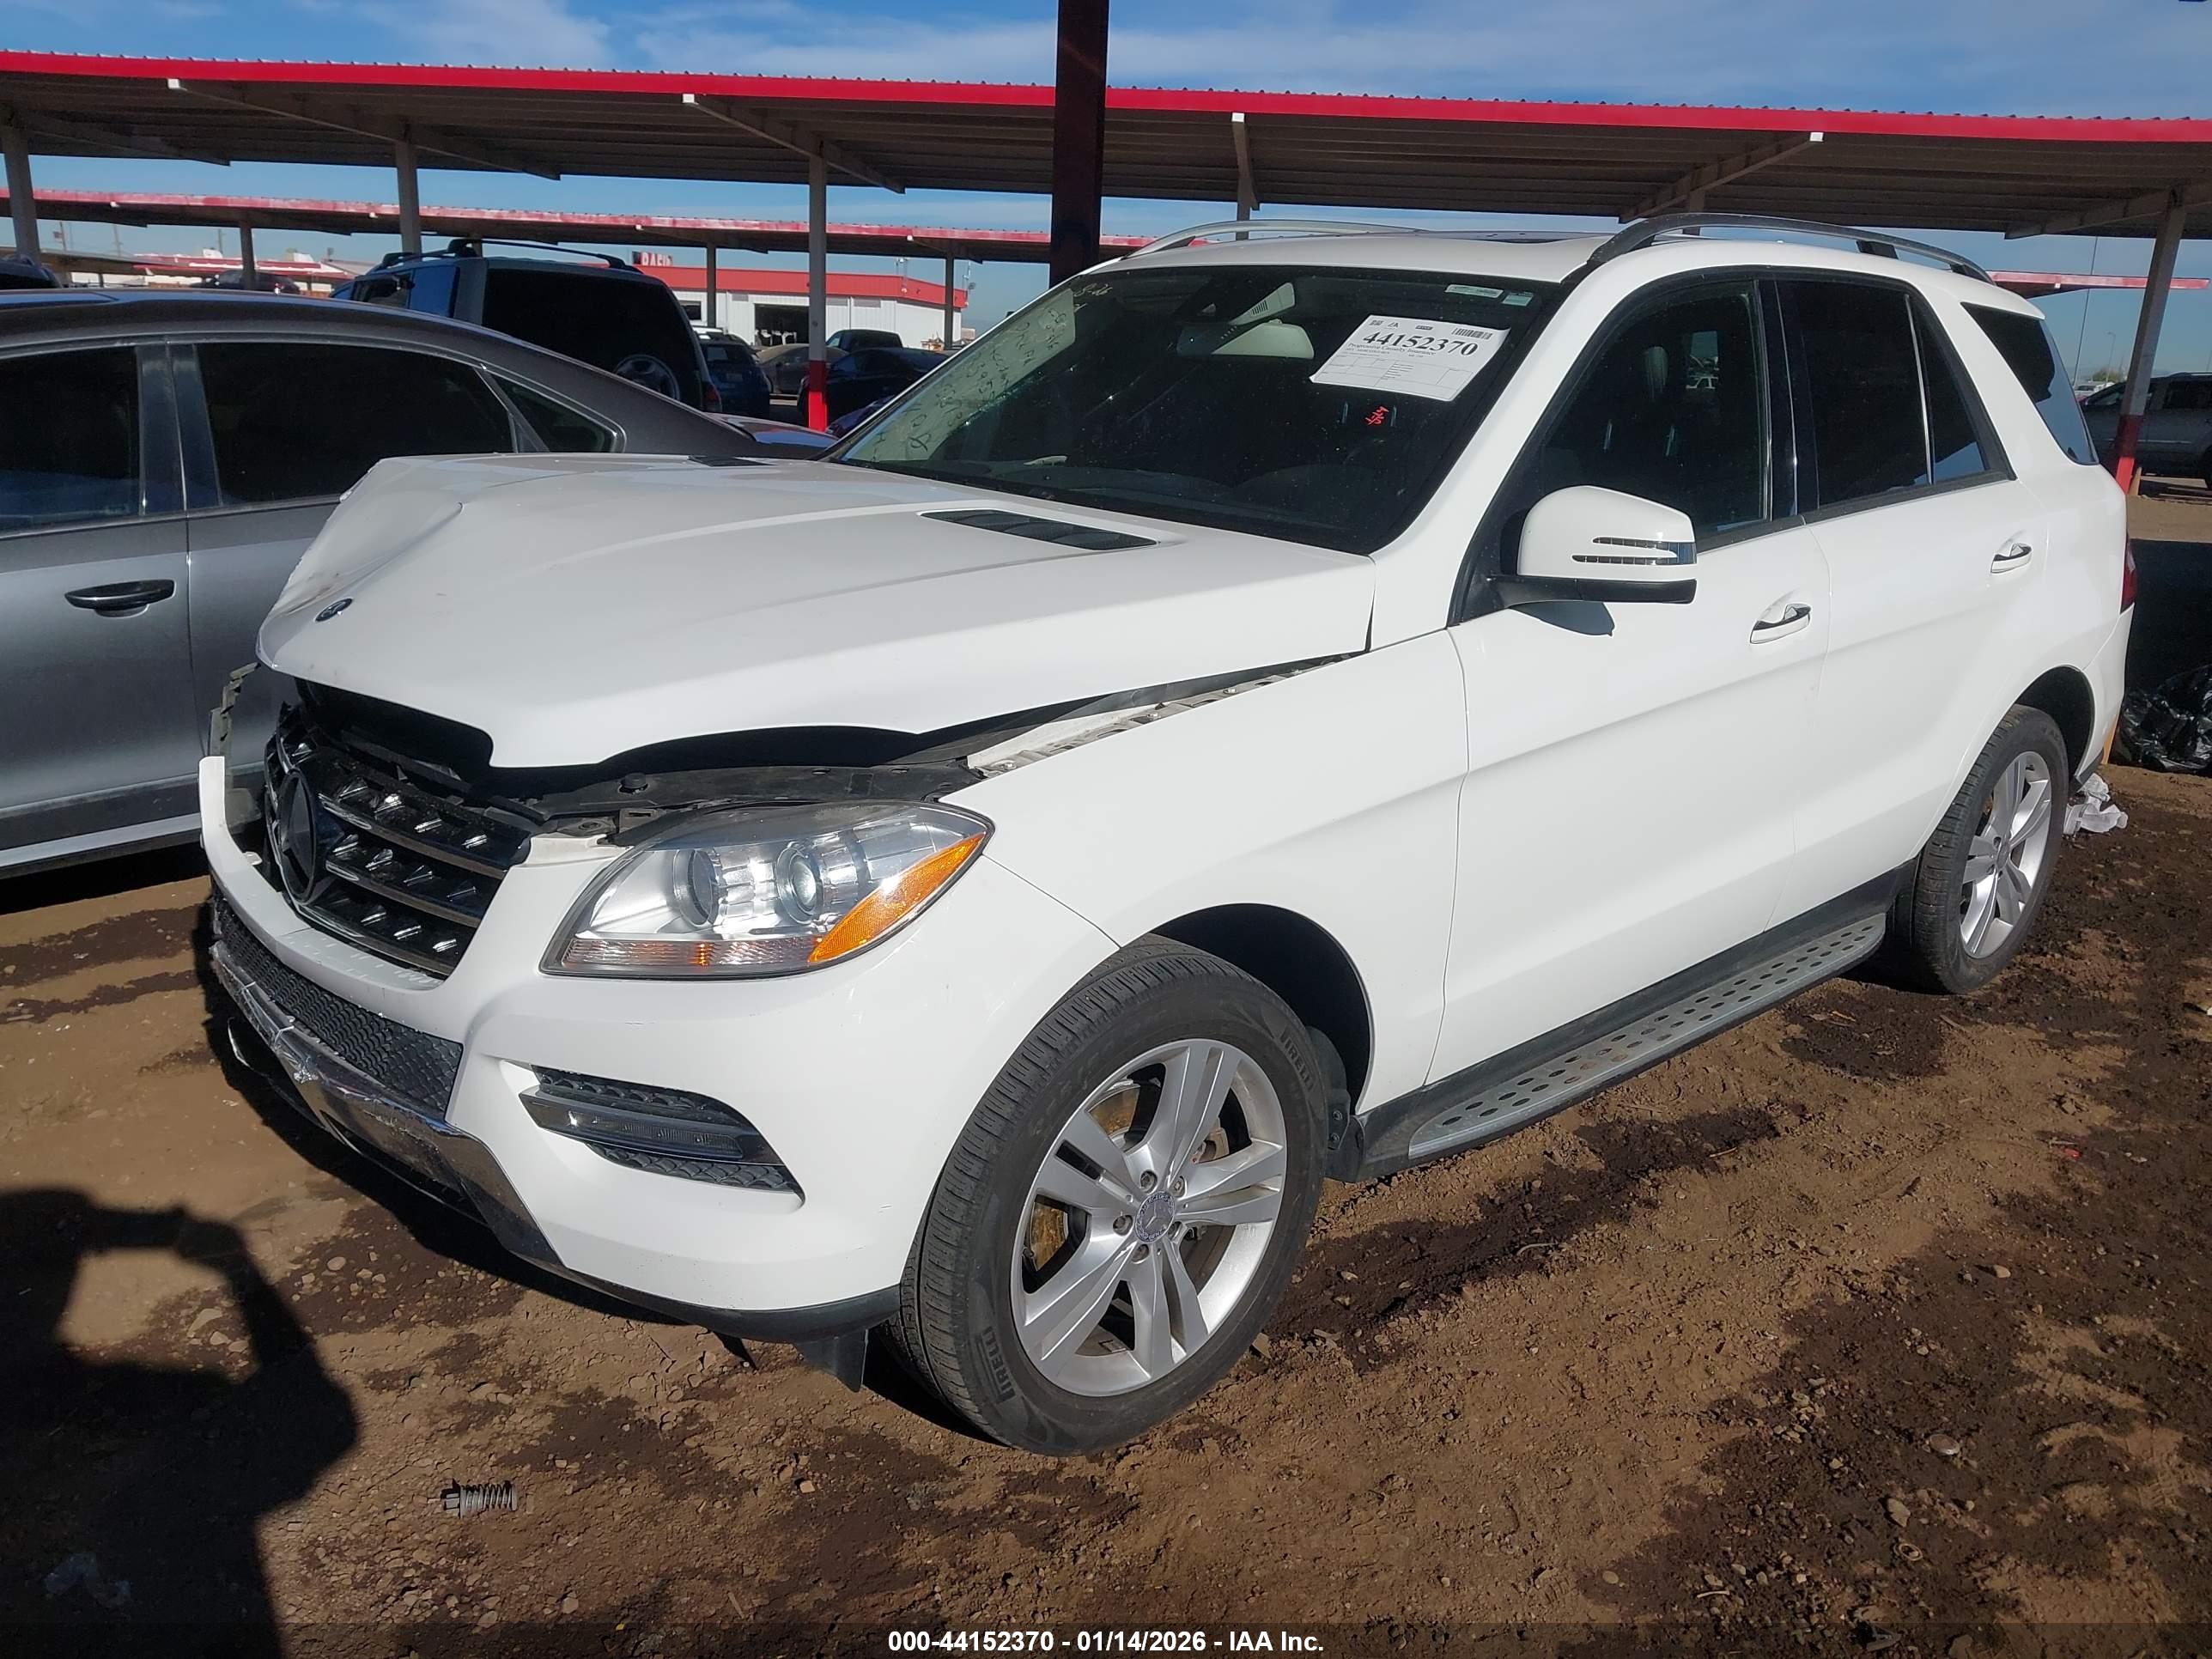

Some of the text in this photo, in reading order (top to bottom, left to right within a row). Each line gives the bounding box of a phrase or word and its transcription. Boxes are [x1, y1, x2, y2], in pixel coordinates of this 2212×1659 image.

[1363, 331, 1480, 356] 44152370
[1279, 1027, 1315, 1091] PIRELLI
[976, 1326, 1016, 1402] PIRELLI
